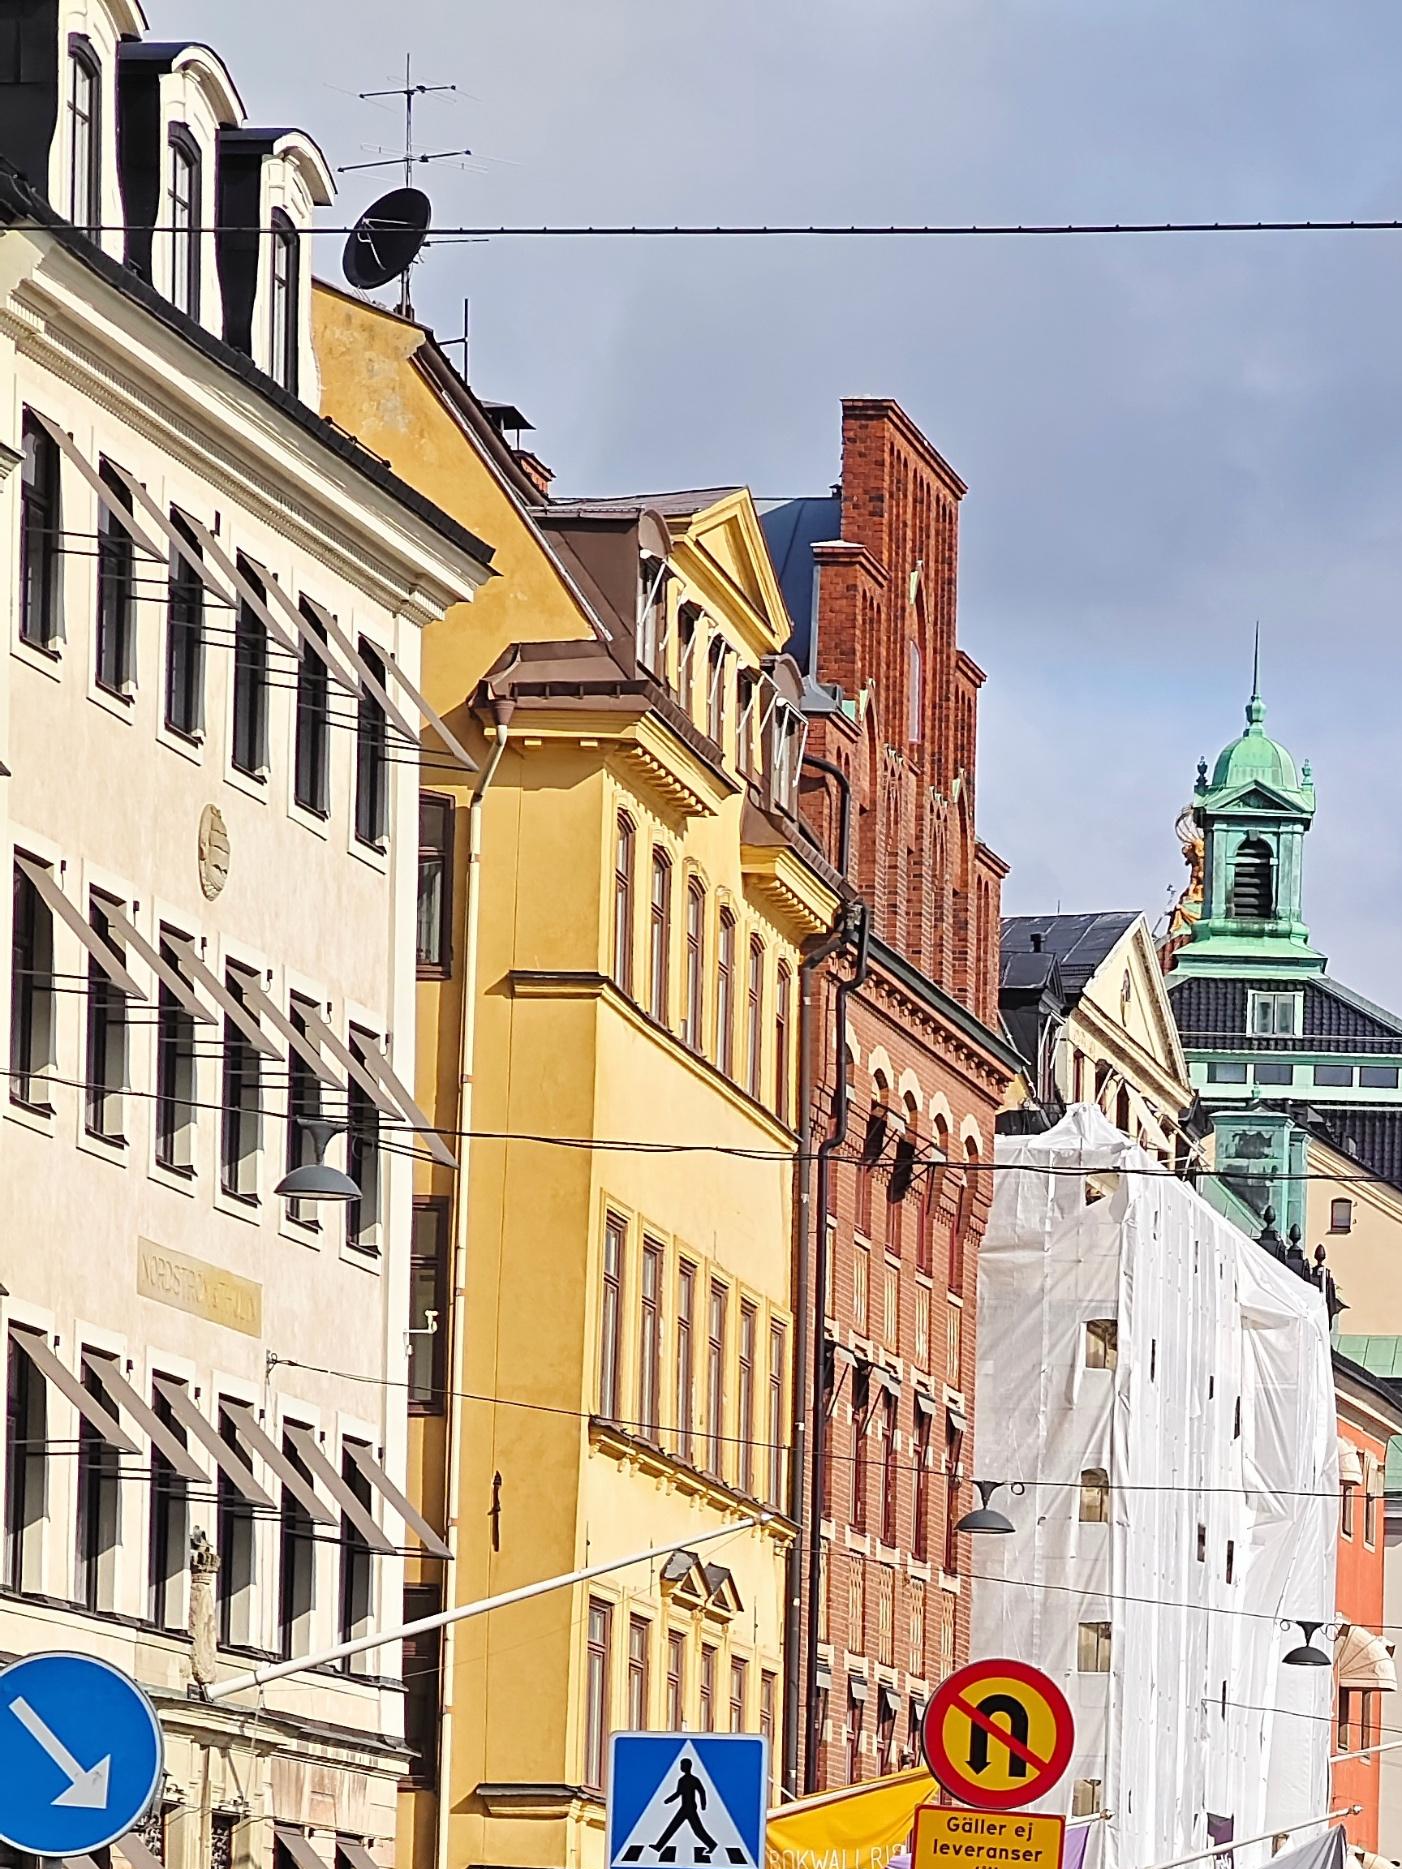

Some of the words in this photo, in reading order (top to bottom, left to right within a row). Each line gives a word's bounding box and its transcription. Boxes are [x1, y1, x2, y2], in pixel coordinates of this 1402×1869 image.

[946, 1816, 1007, 1836] Gäller
[1014, 1822, 1034, 1841] ej
[933, 1839, 1043, 1862] leveranser
